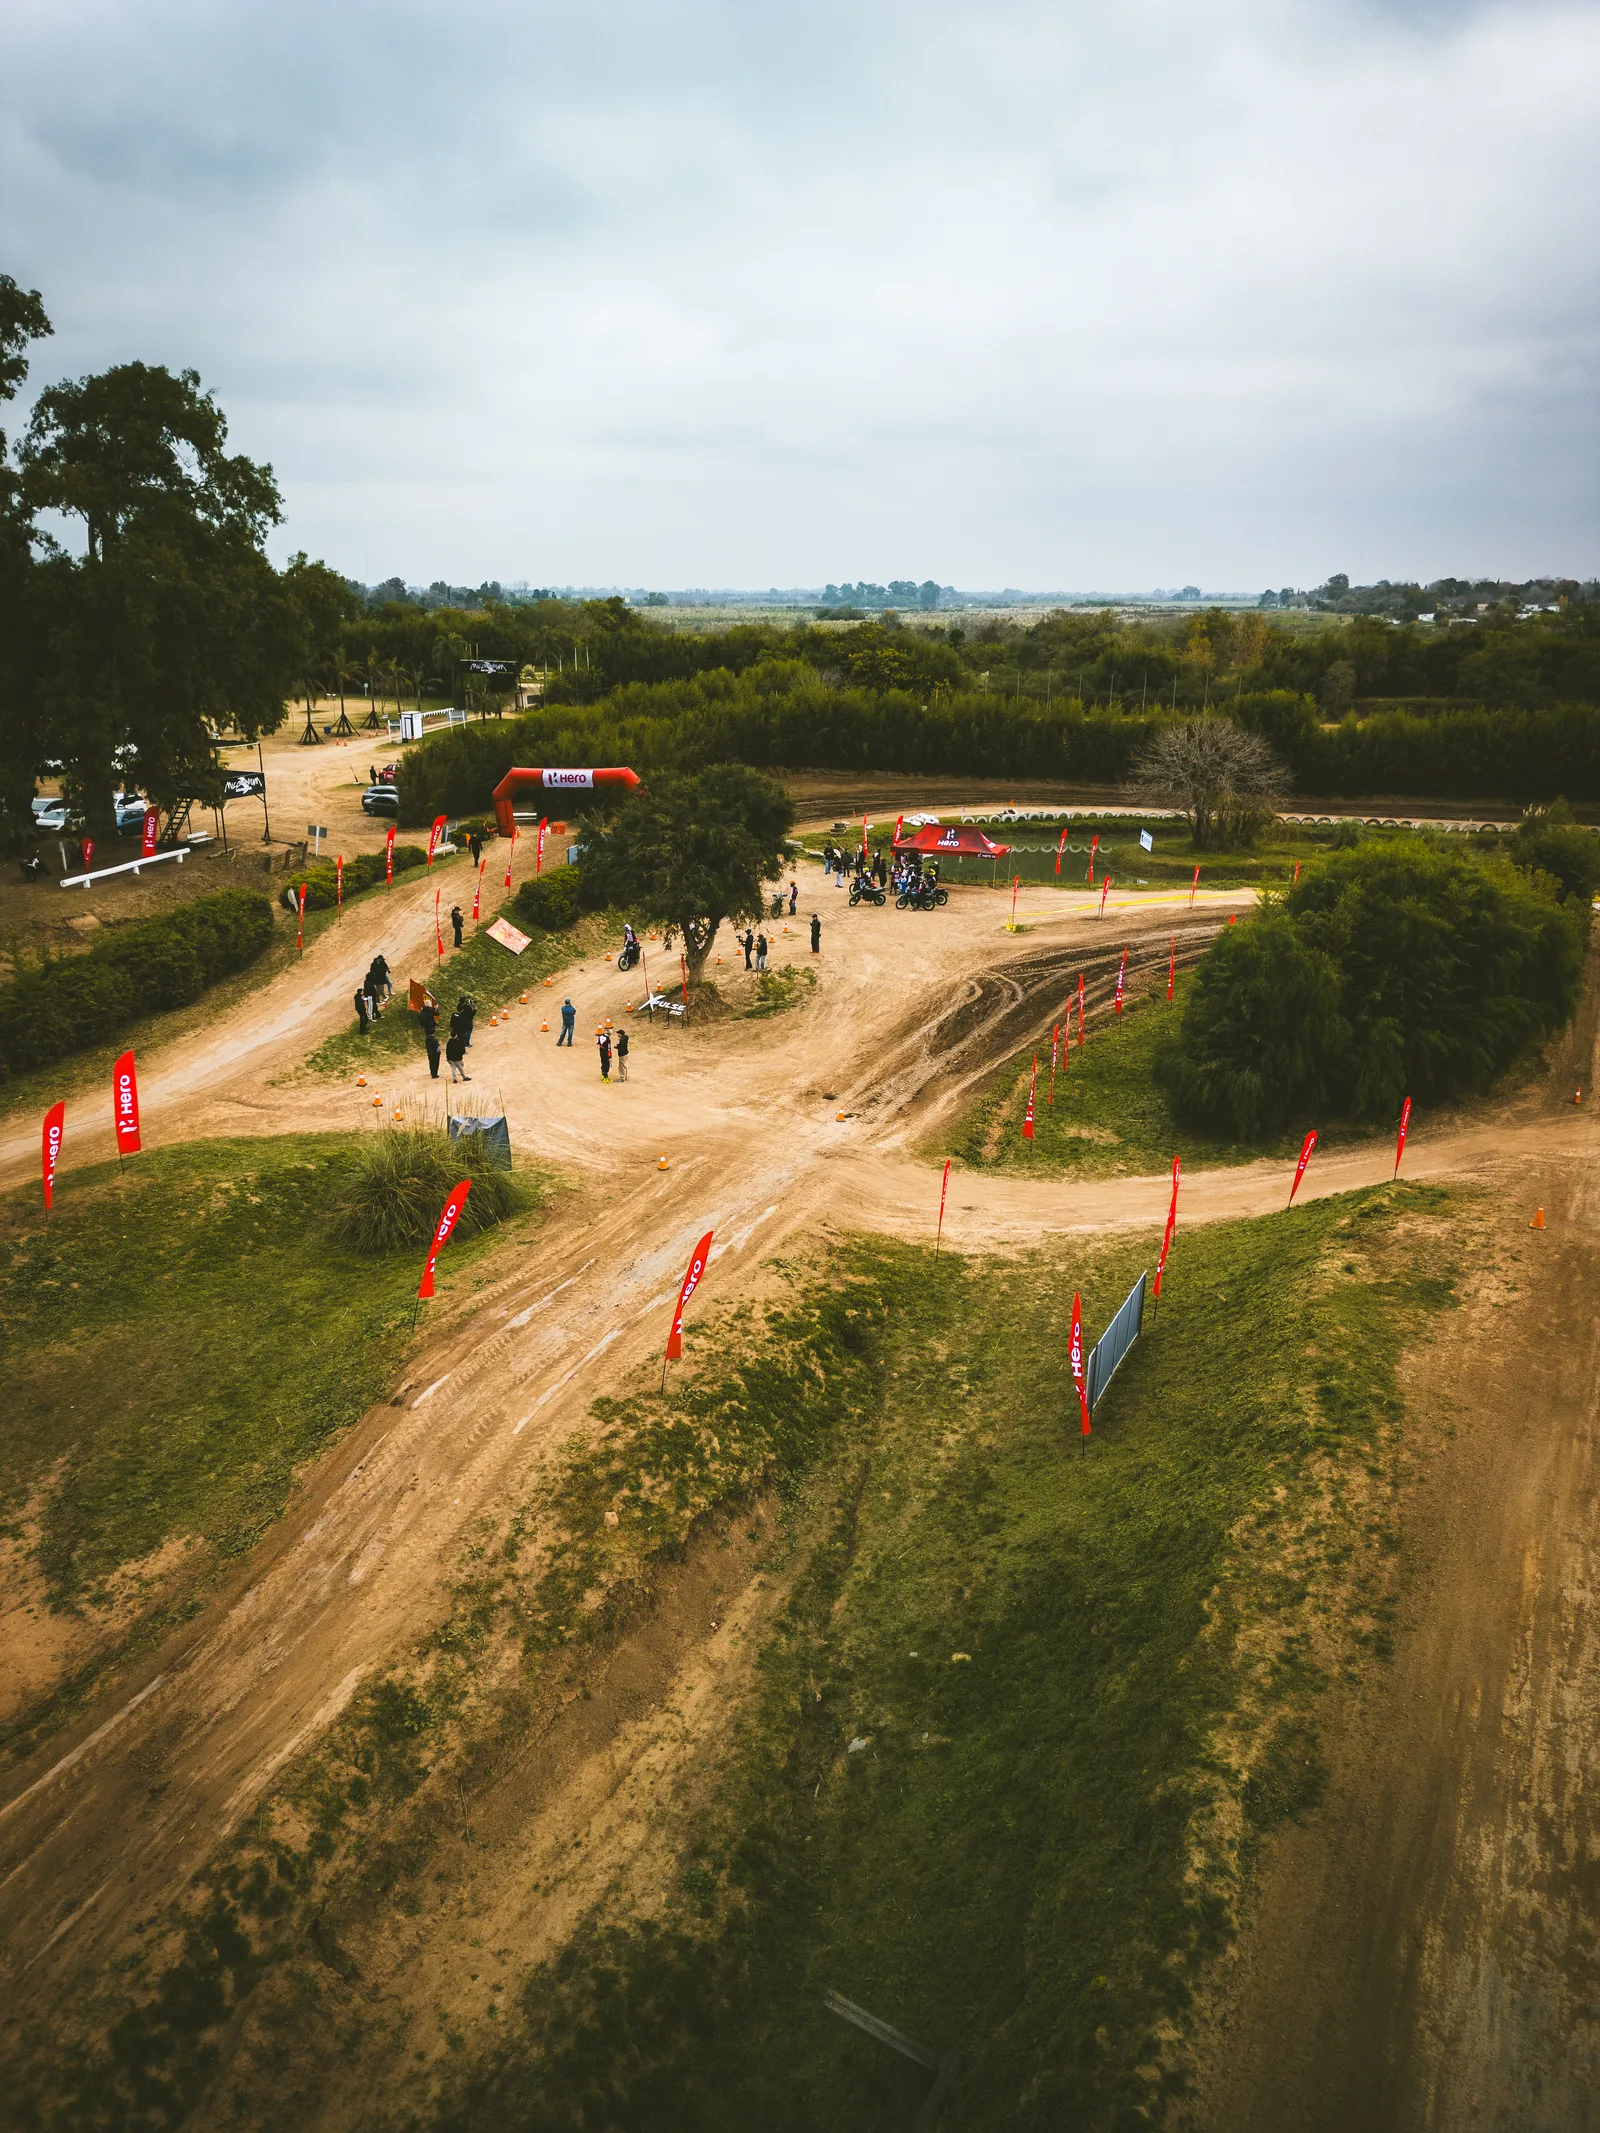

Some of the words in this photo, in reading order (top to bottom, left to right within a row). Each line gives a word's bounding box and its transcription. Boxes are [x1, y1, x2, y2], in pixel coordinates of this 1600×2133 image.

[560, 774, 586, 783] Hero
[146, 816, 156, 838] Hero
[637, 991, 687, 1011] XPULSE
[119, 1074, 133, 1115] Hero
[437, 1204, 457, 1241] ero
[1071, 1322, 1083, 1378] Hero
